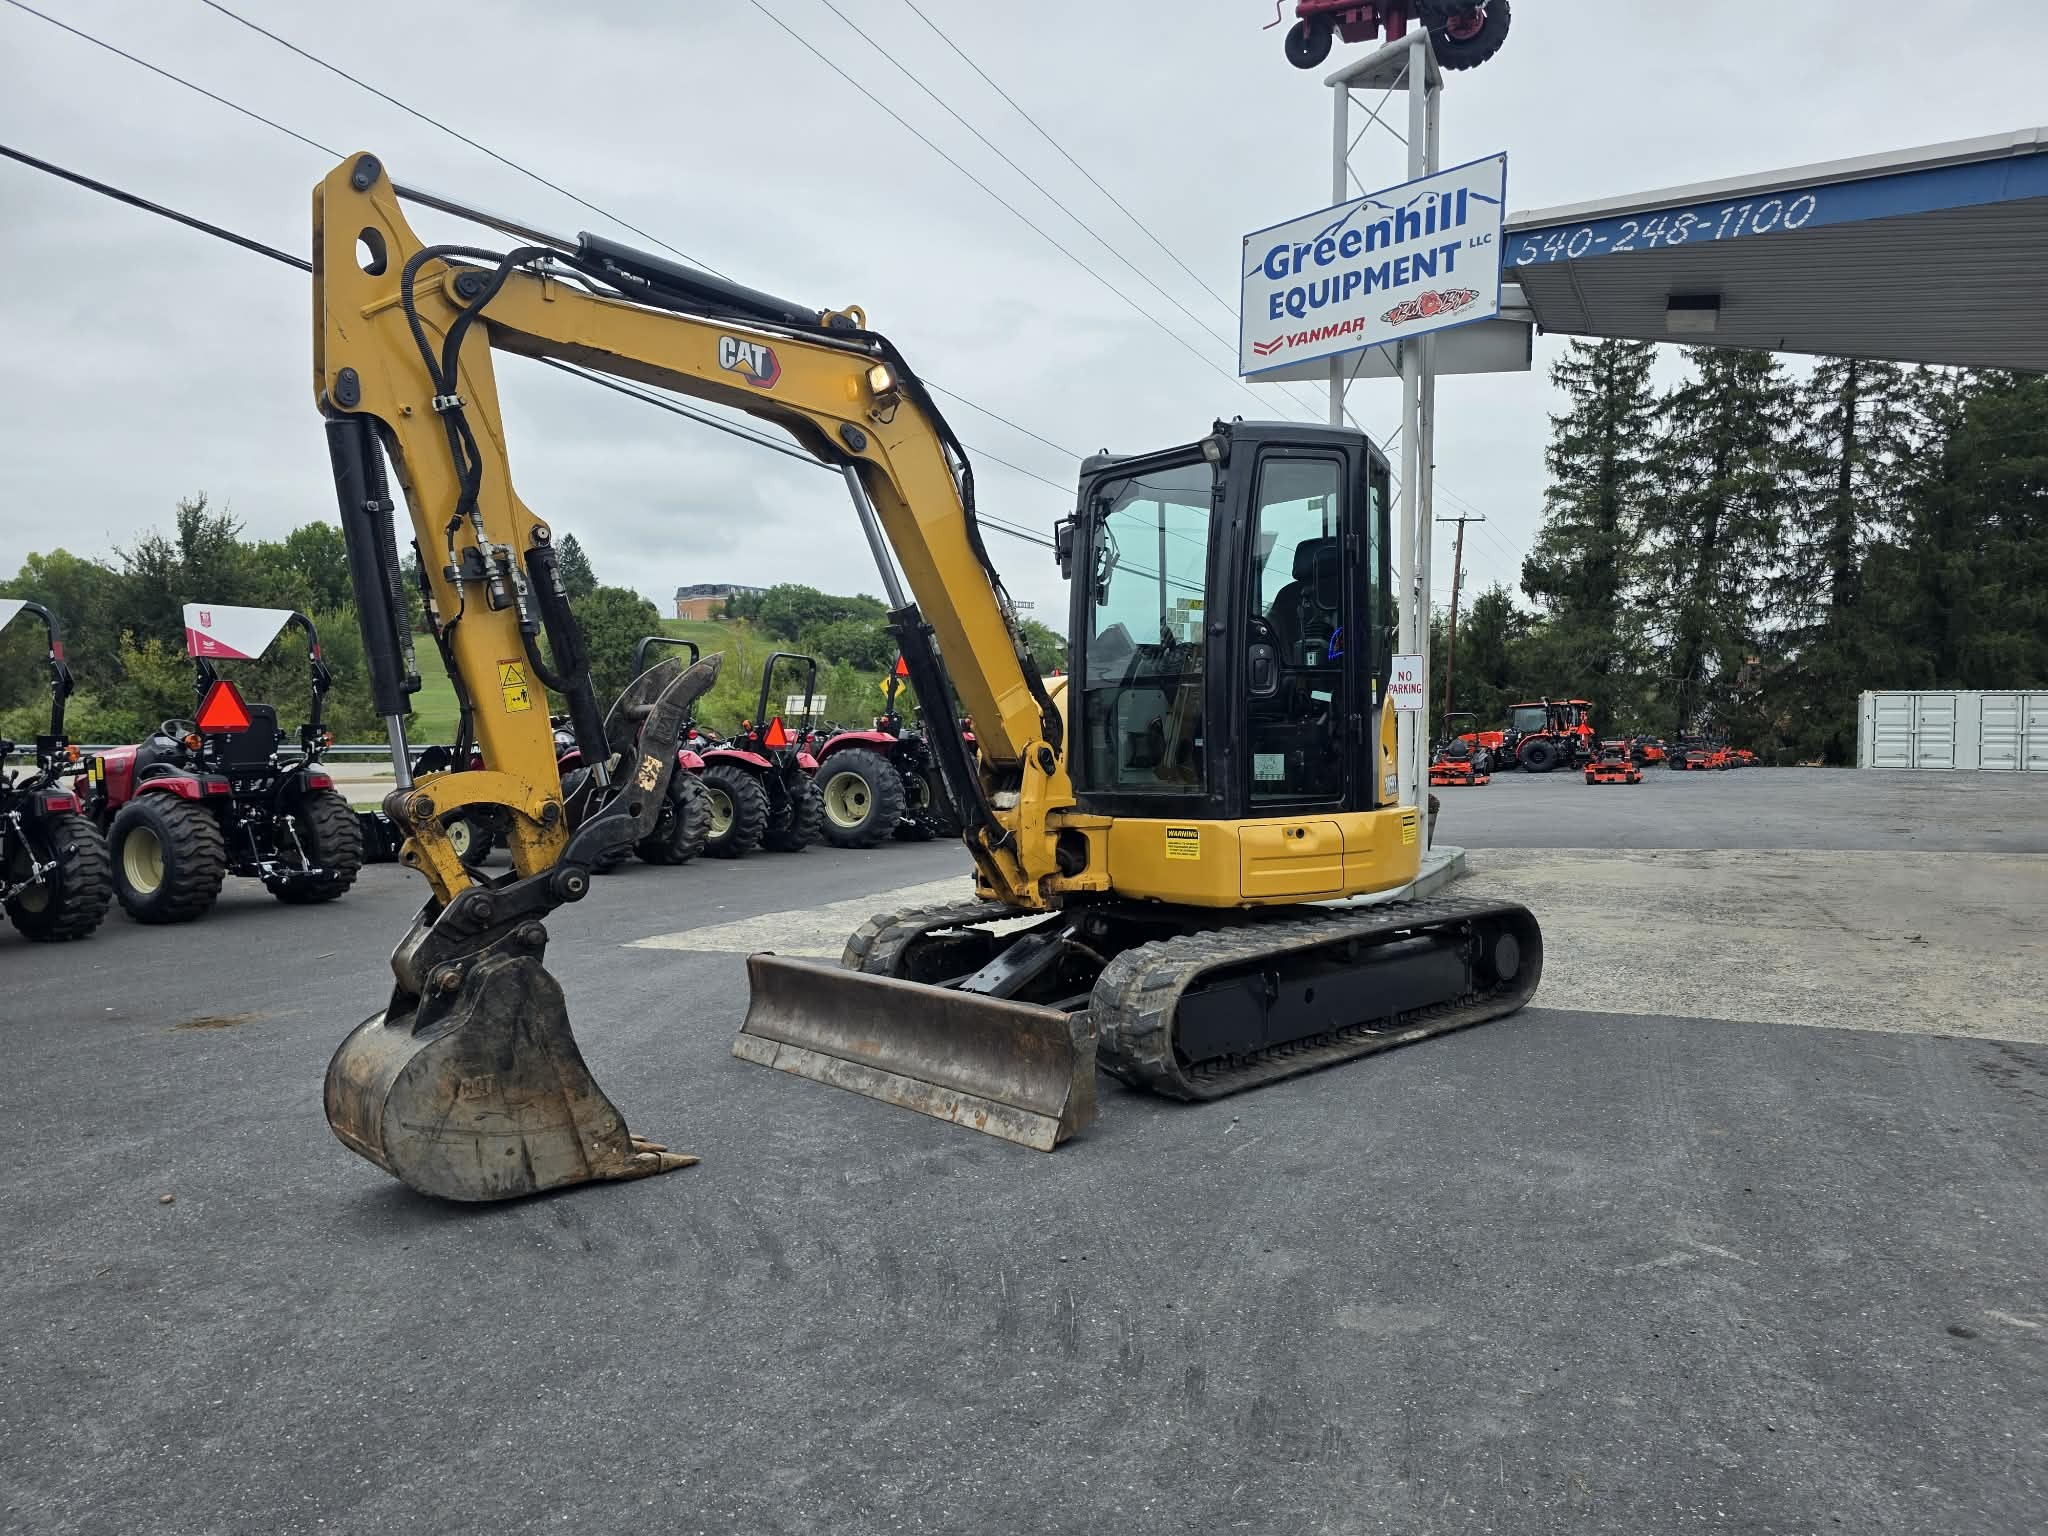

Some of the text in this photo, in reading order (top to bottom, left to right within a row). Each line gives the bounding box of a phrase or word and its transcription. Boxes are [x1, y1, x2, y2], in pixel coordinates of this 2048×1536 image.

[1263, 187, 1468, 280] Greenhill
[1515, 193, 1817, 266] 540-248-1100
[1268, 232, 1492, 320] EQUIPMENT LLC
[1286, 316, 1365, 348] YANMAR
[719, 335, 767, 377] CAT
[1388, 683, 1422, 695] PARKING
[1398, 670, 1412, 682] NO
[1167, 829, 1198, 838] WARNING
